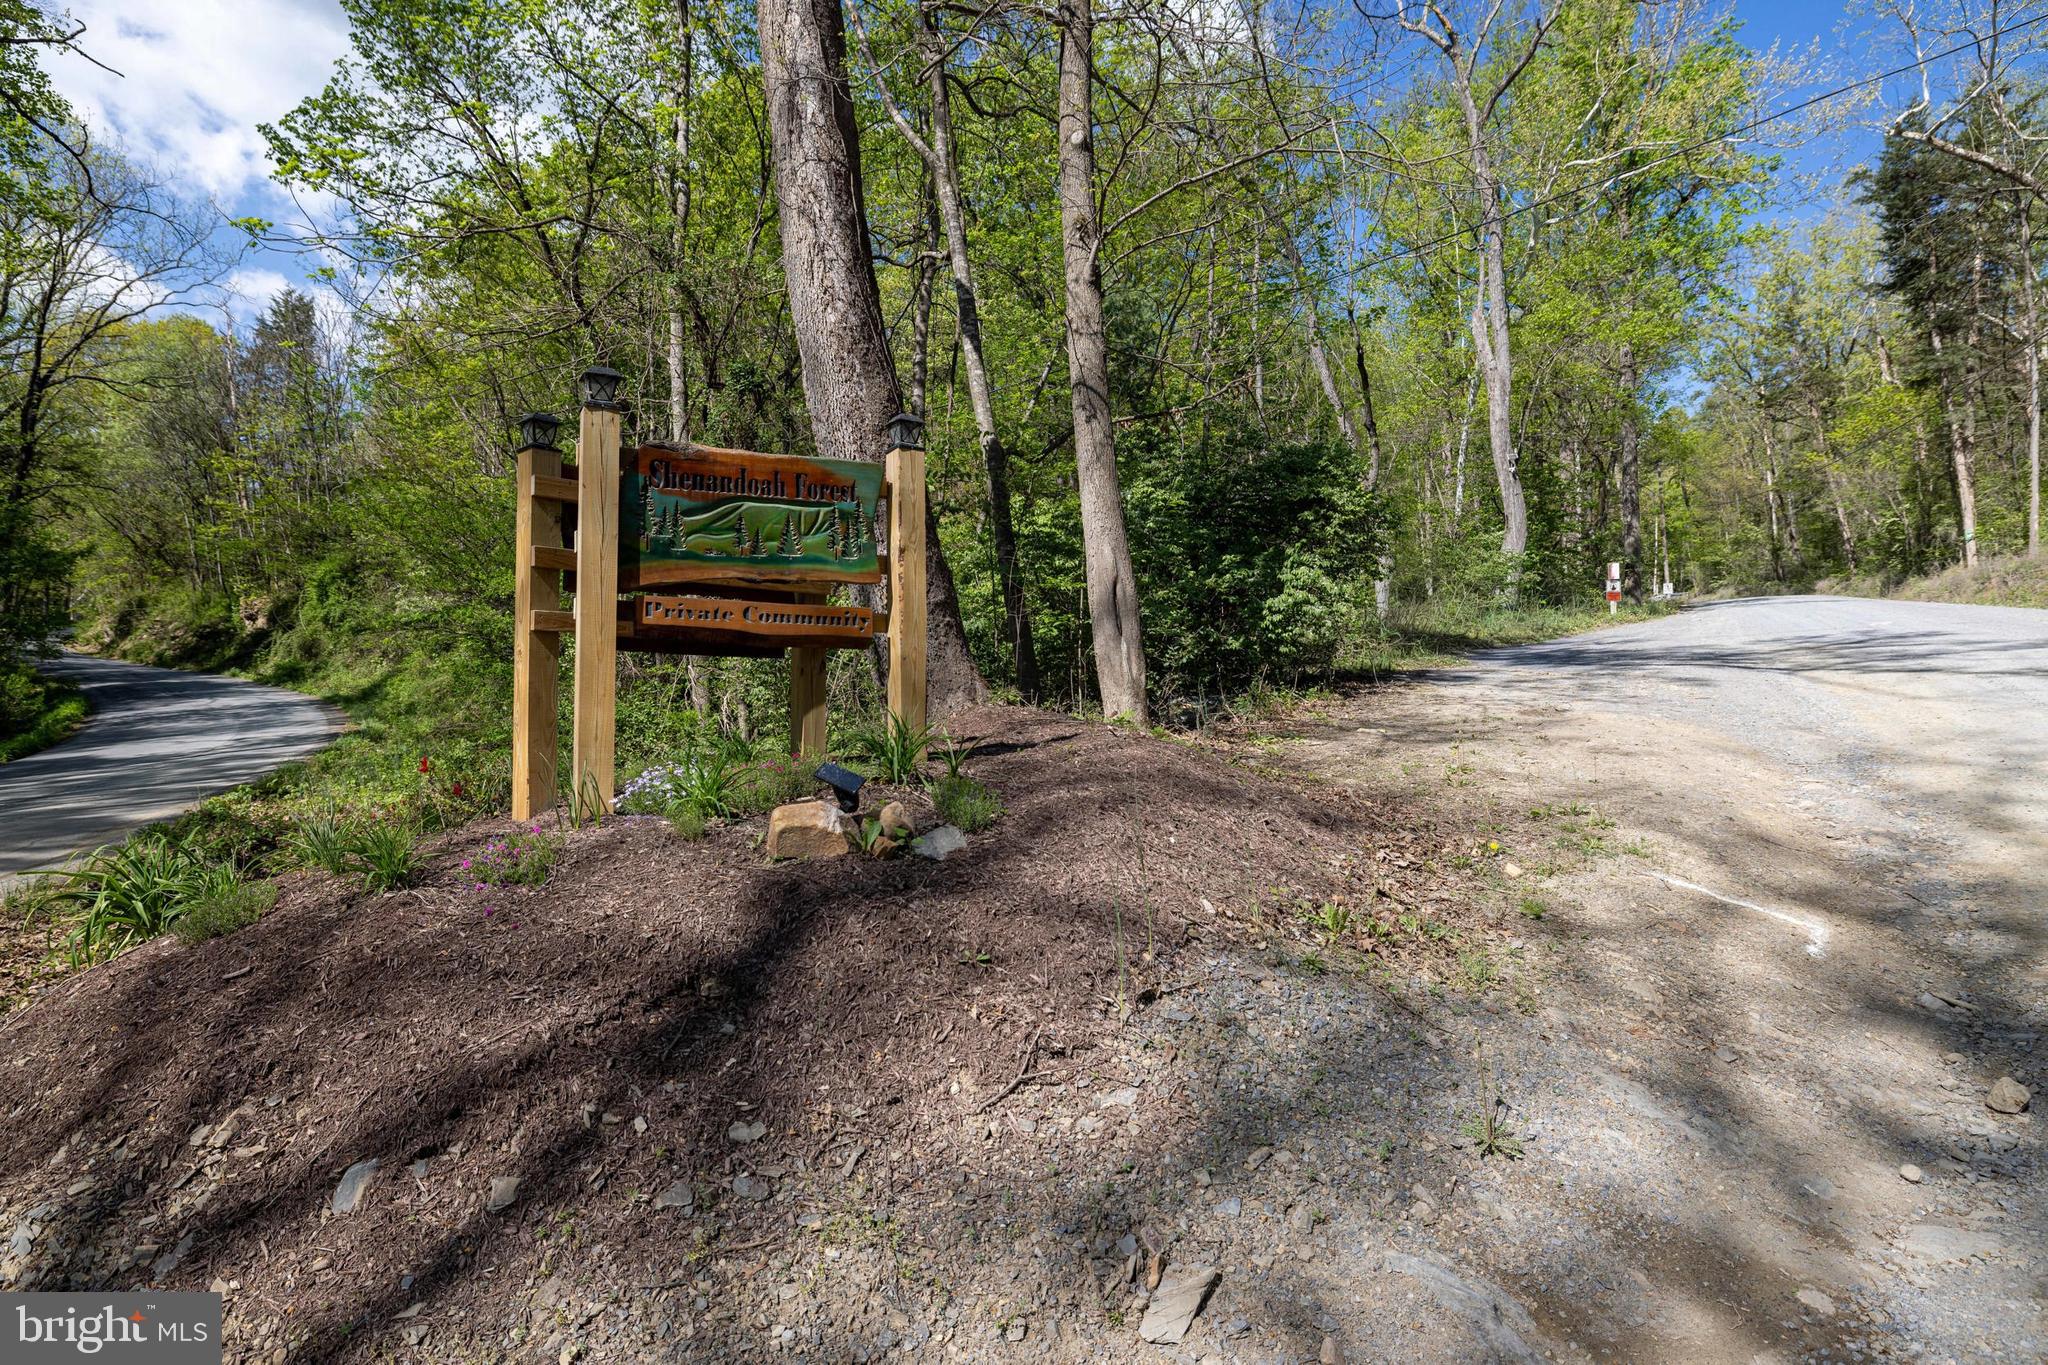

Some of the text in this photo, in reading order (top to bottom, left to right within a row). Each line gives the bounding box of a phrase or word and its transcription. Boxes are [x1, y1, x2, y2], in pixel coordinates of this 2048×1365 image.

[648, 459, 858, 502] Shenandoah Forest
[645, 601, 871, 632] Private Community
